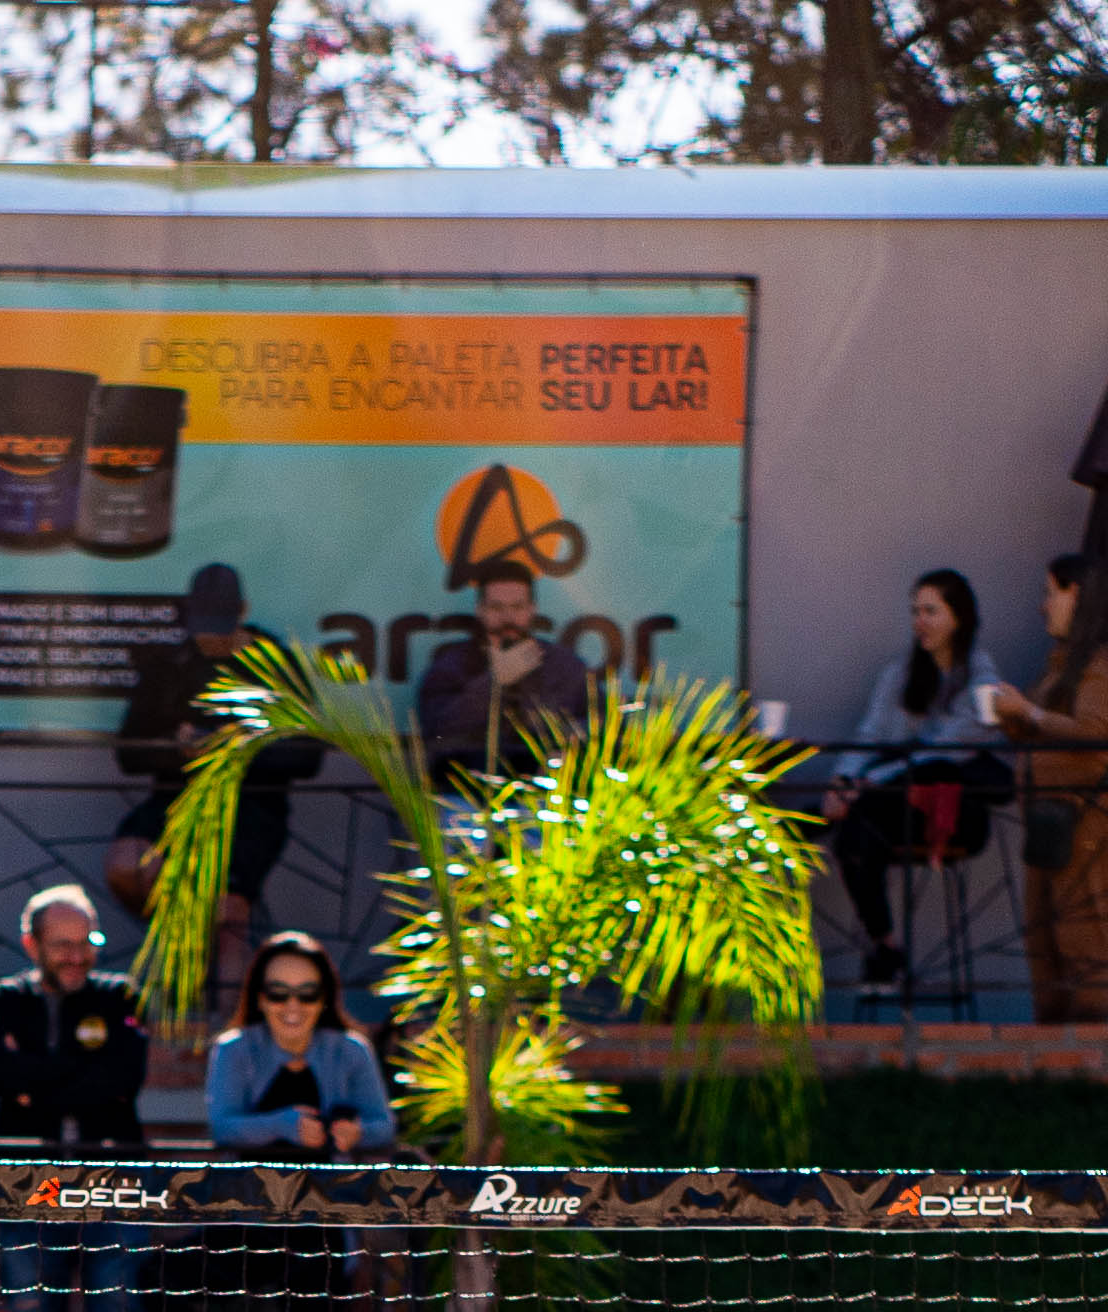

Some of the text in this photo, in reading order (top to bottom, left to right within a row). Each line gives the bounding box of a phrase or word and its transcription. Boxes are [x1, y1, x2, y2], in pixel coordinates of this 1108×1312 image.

[140, 340, 709, 375] DESCUBRA A PALETA PERFEITA
[219, 378, 709, 411] PARA ENCANTAR SEU LAR!
[317, 611, 679, 684] araor
